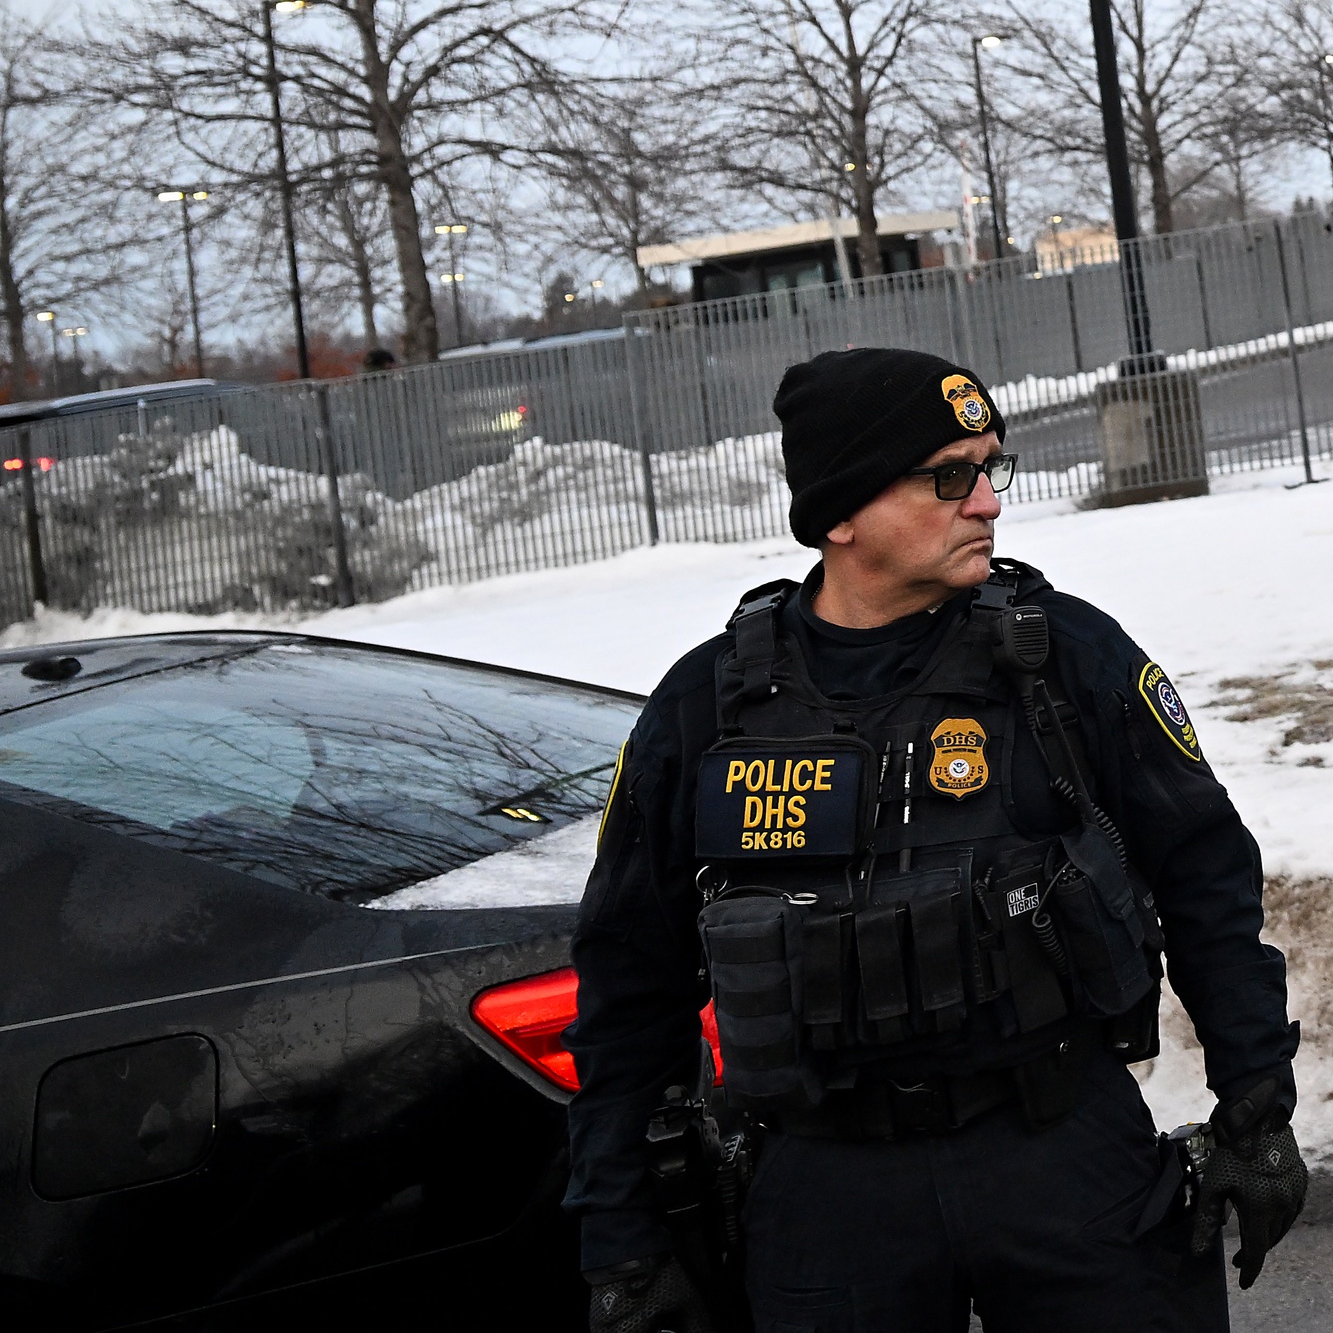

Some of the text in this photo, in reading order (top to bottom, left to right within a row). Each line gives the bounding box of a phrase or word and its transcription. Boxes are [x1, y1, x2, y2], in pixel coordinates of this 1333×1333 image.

[943, 735, 977, 746] DHS
[725, 759, 835, 793] POLICE
[743, 795, 807, 829] DHS
[1009, 888, 1026, 903] ONE
[1010, 897, 1038, 915] TIGRIS
